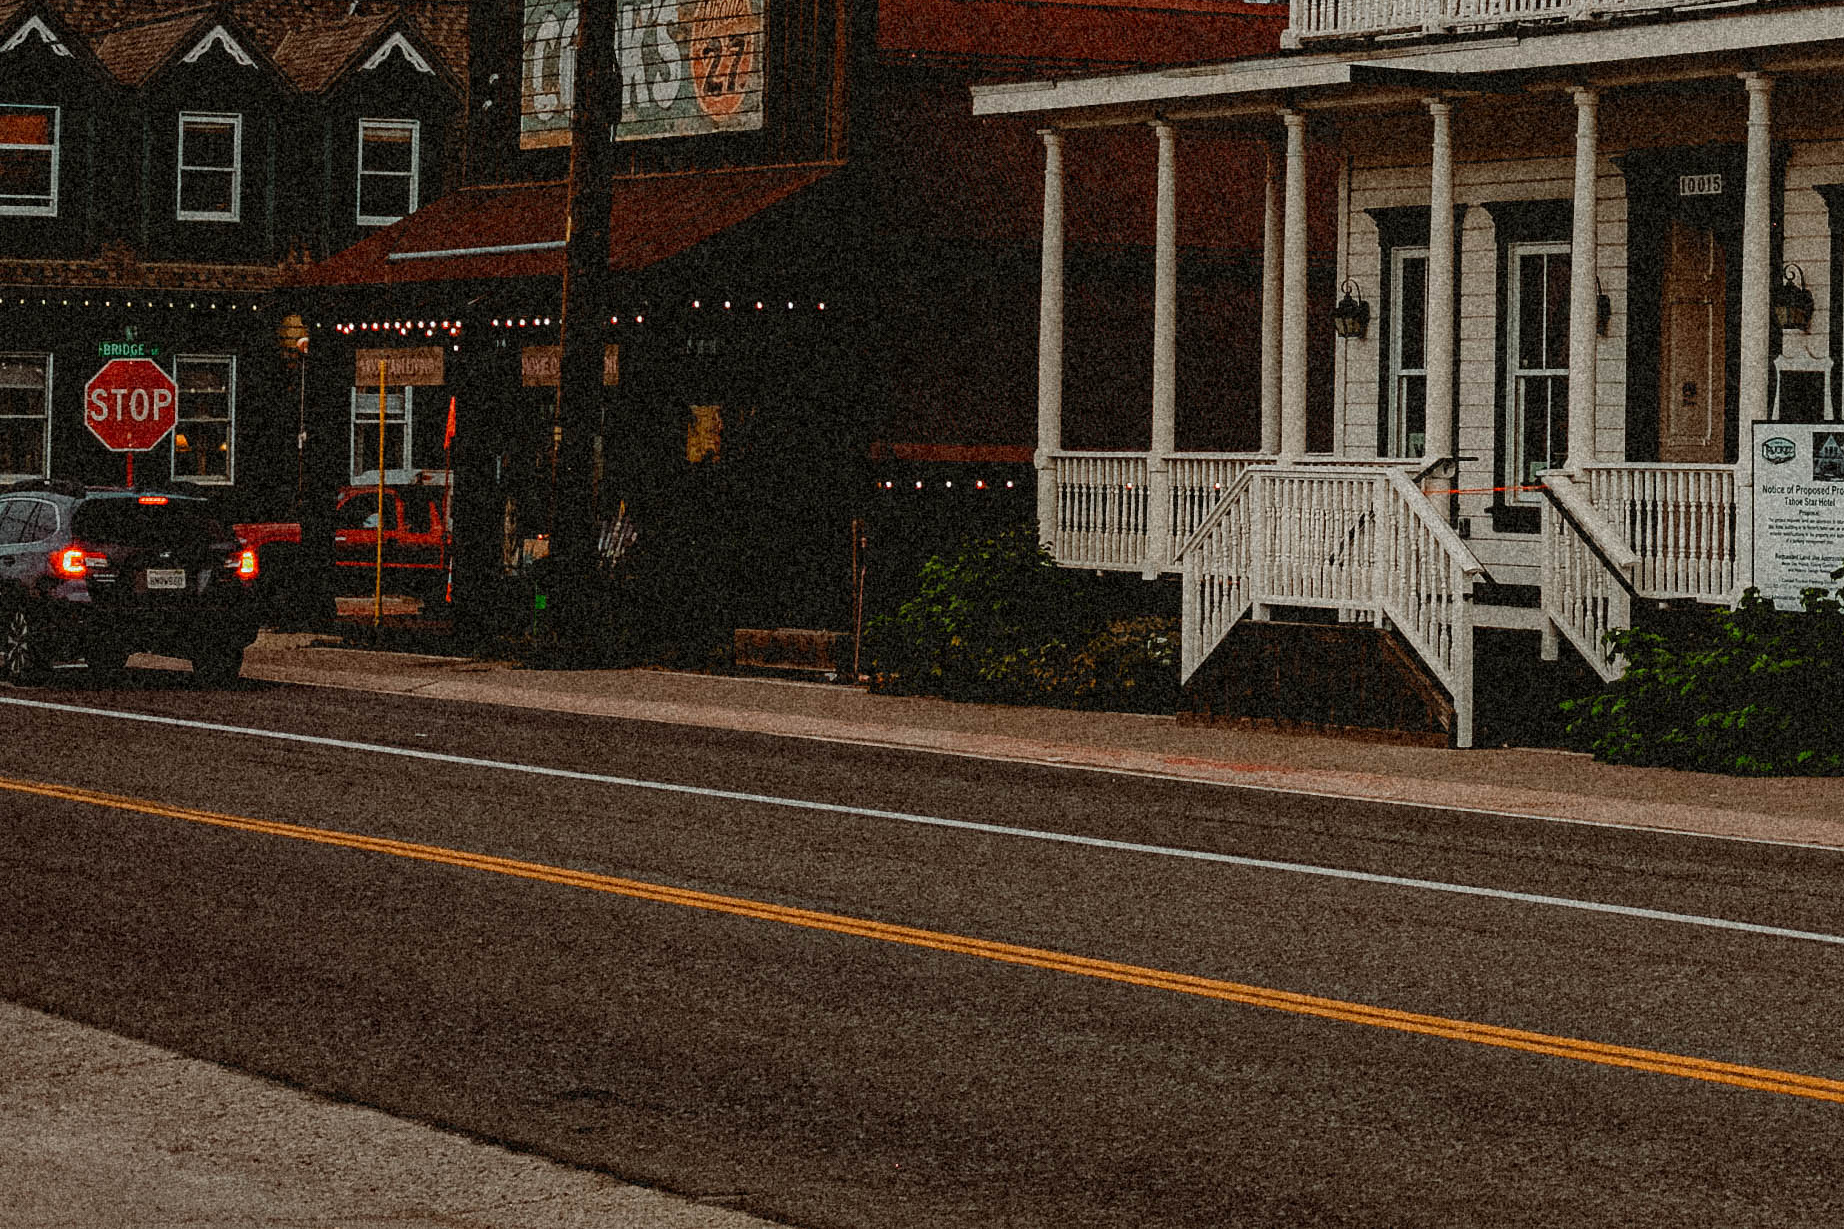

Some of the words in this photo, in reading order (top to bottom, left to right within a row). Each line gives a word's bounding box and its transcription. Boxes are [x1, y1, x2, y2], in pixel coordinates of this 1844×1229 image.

[701, 35, 746, 98] 27
[1681, 176, 1720, 193] 10015
[103, 343, 145, 356] BRIDGE
[90, 388, 172, 422] STOP
[1762, 484, 1785, 494] Notice
[1786, 485, 1795, 495] of
[1796, 485, 1830, 497] Proposed
[1784, 497, 1803, 506] Tahoe
[1804, 498, 1818, 506] Star
[1819, 498, 1836, 507] Hotel
